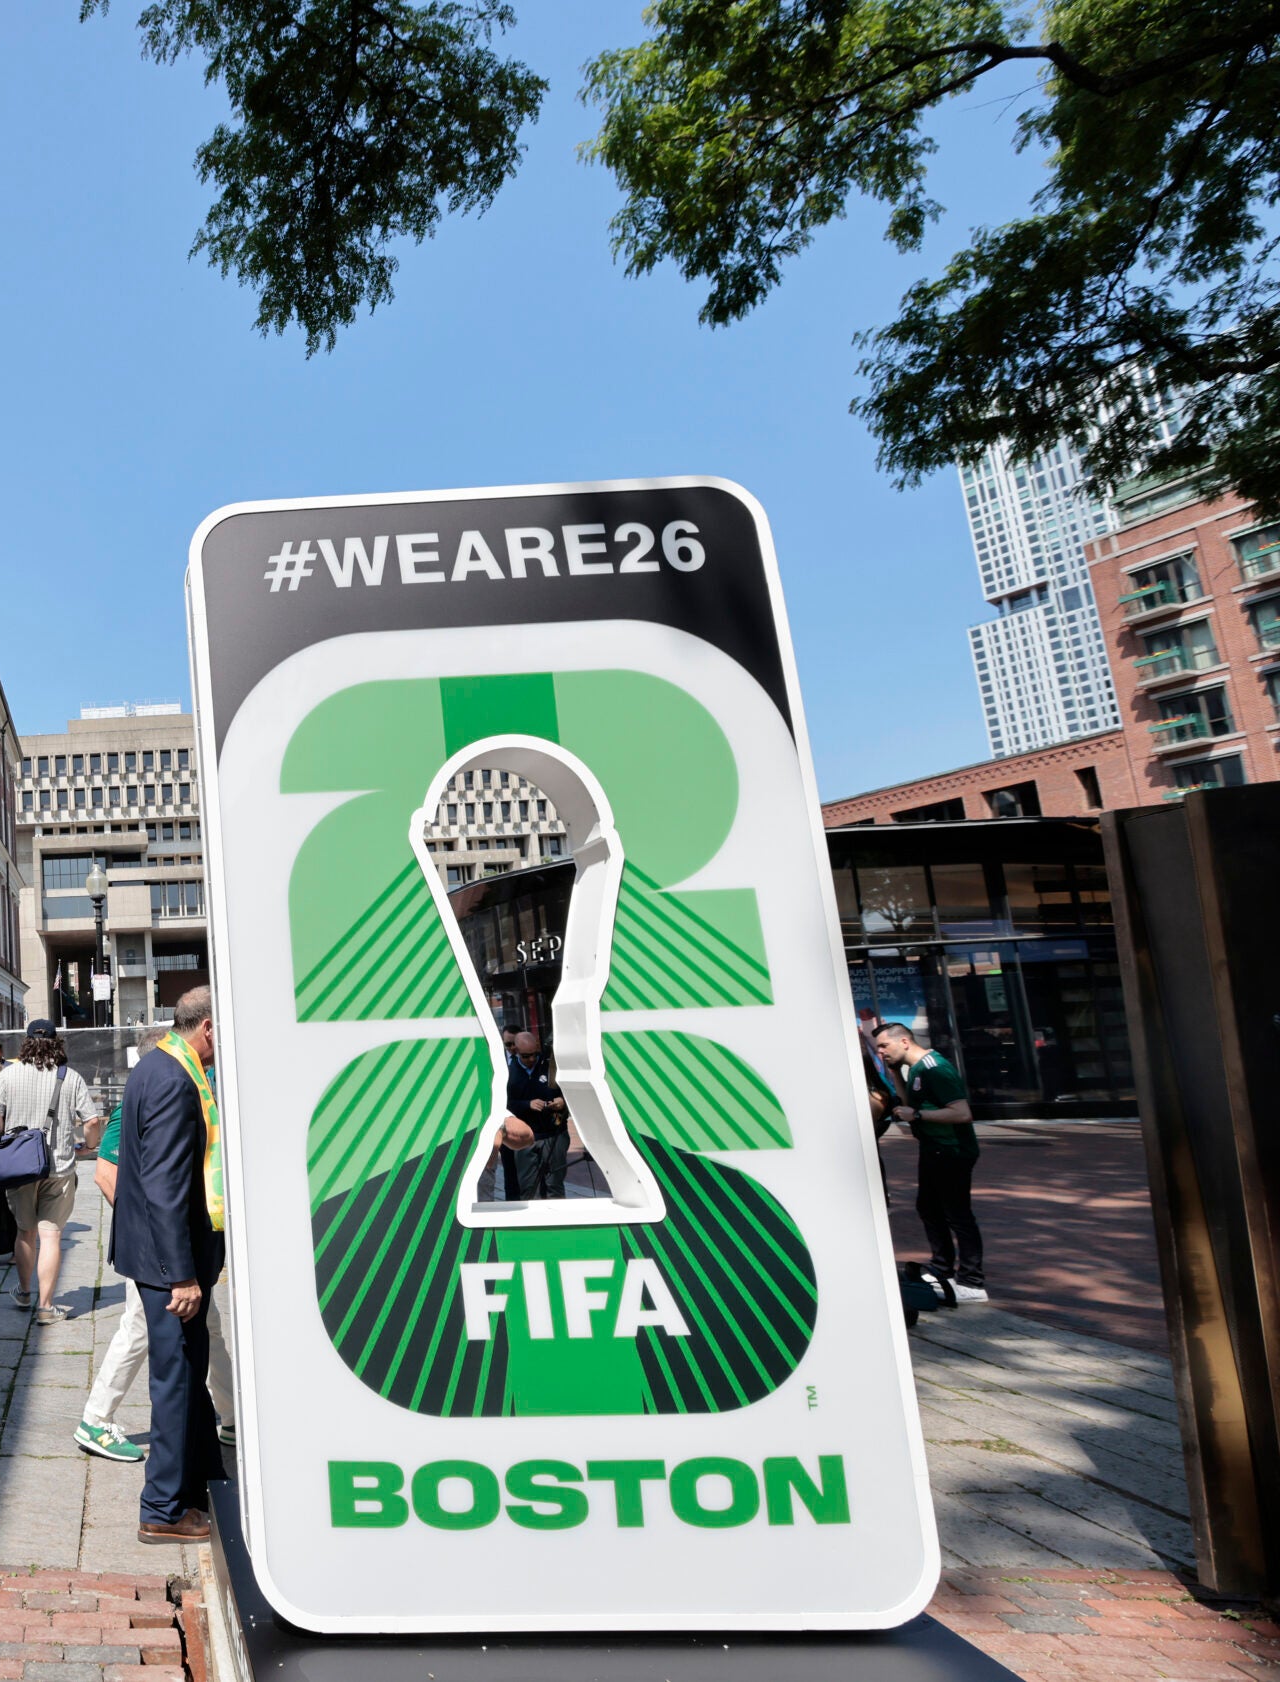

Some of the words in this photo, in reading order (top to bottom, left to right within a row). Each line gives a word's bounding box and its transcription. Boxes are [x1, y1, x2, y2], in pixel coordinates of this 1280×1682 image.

[263, 519, 706, 593] #WEARE26
[516, 936, 562, 964] SEP
[460, 1258, 692, 1341] FIFA
[805, 1385, 818, 1411] TM
[97, 1433, 114, 1448] N
[327, 1454, 852, 1531] BOSTON
